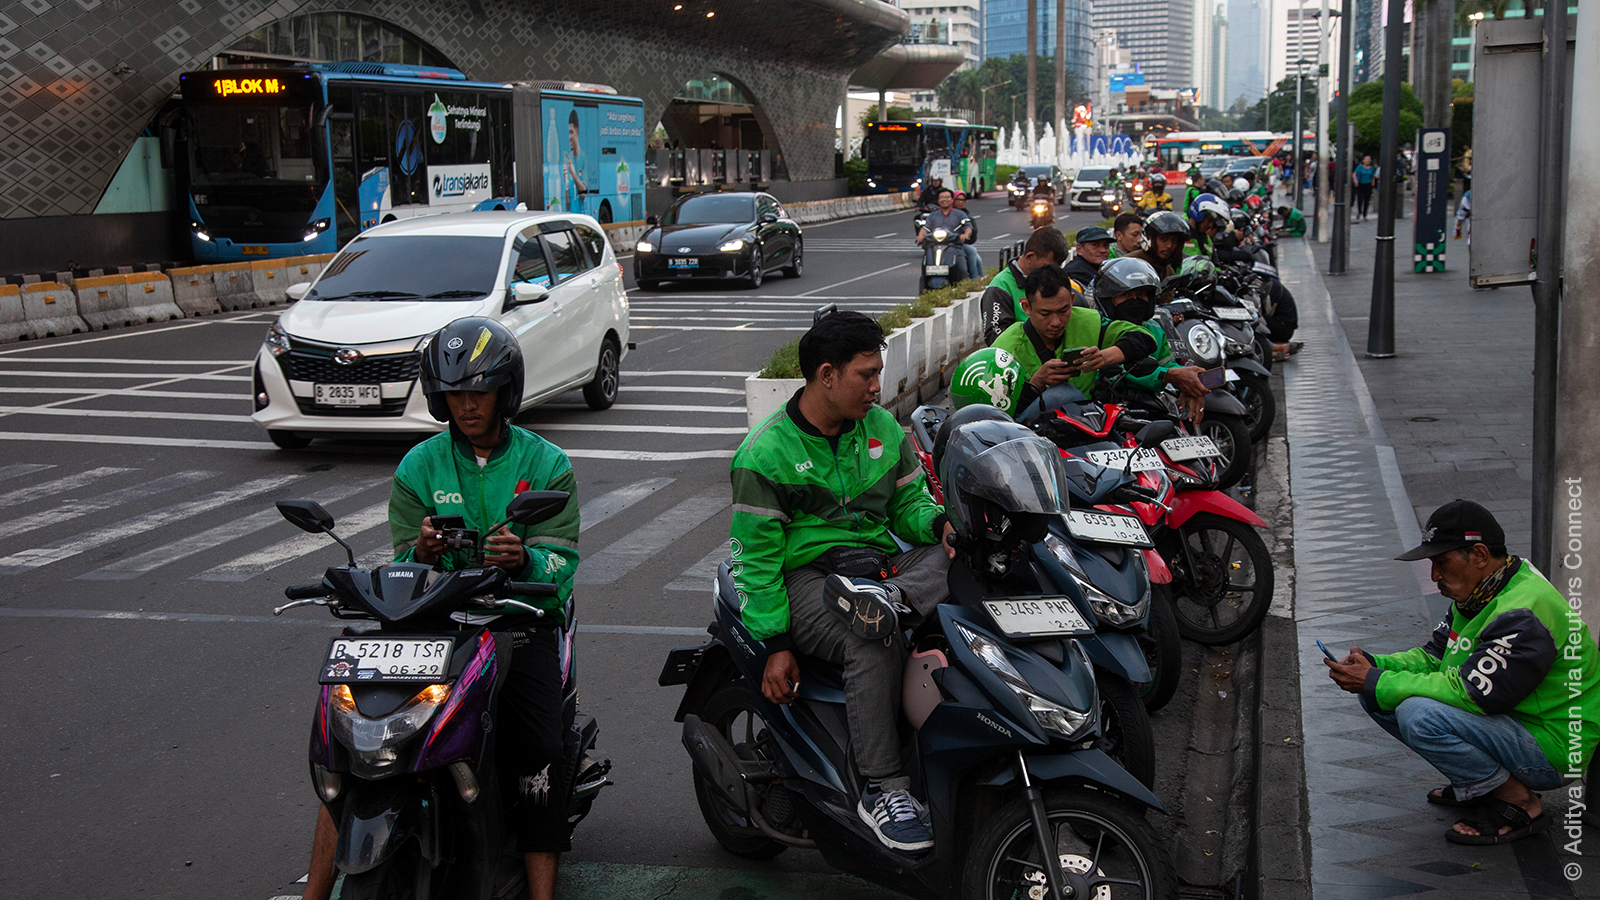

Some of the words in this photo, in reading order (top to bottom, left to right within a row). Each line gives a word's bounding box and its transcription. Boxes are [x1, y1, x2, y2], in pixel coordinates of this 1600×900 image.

[265, 79, 279, 93] M
[447, 105, 469, 117] Sehatnya
[470, 106, 486, 116] Mineral
[455, 119, 481, 131] Terlindungi
[443, 172, 489, 197] transjakarta
[317, 386, 324, 398] B
[329, 386, 355, 398] 2835
[1164, 441, 1172, 450] B
[433, 490, 465, 504] Gra
[1083, 514, 1116, 527] 6593
[988, 604, 1002, 616] B
[1005, 602, 1042, 616] 3469
[335, 643, 347, 659] B
[357, 643, 404, 658] 5218
[414, 643, 445, 658] TSR
[976, 711, 1013, 739] HONDA
